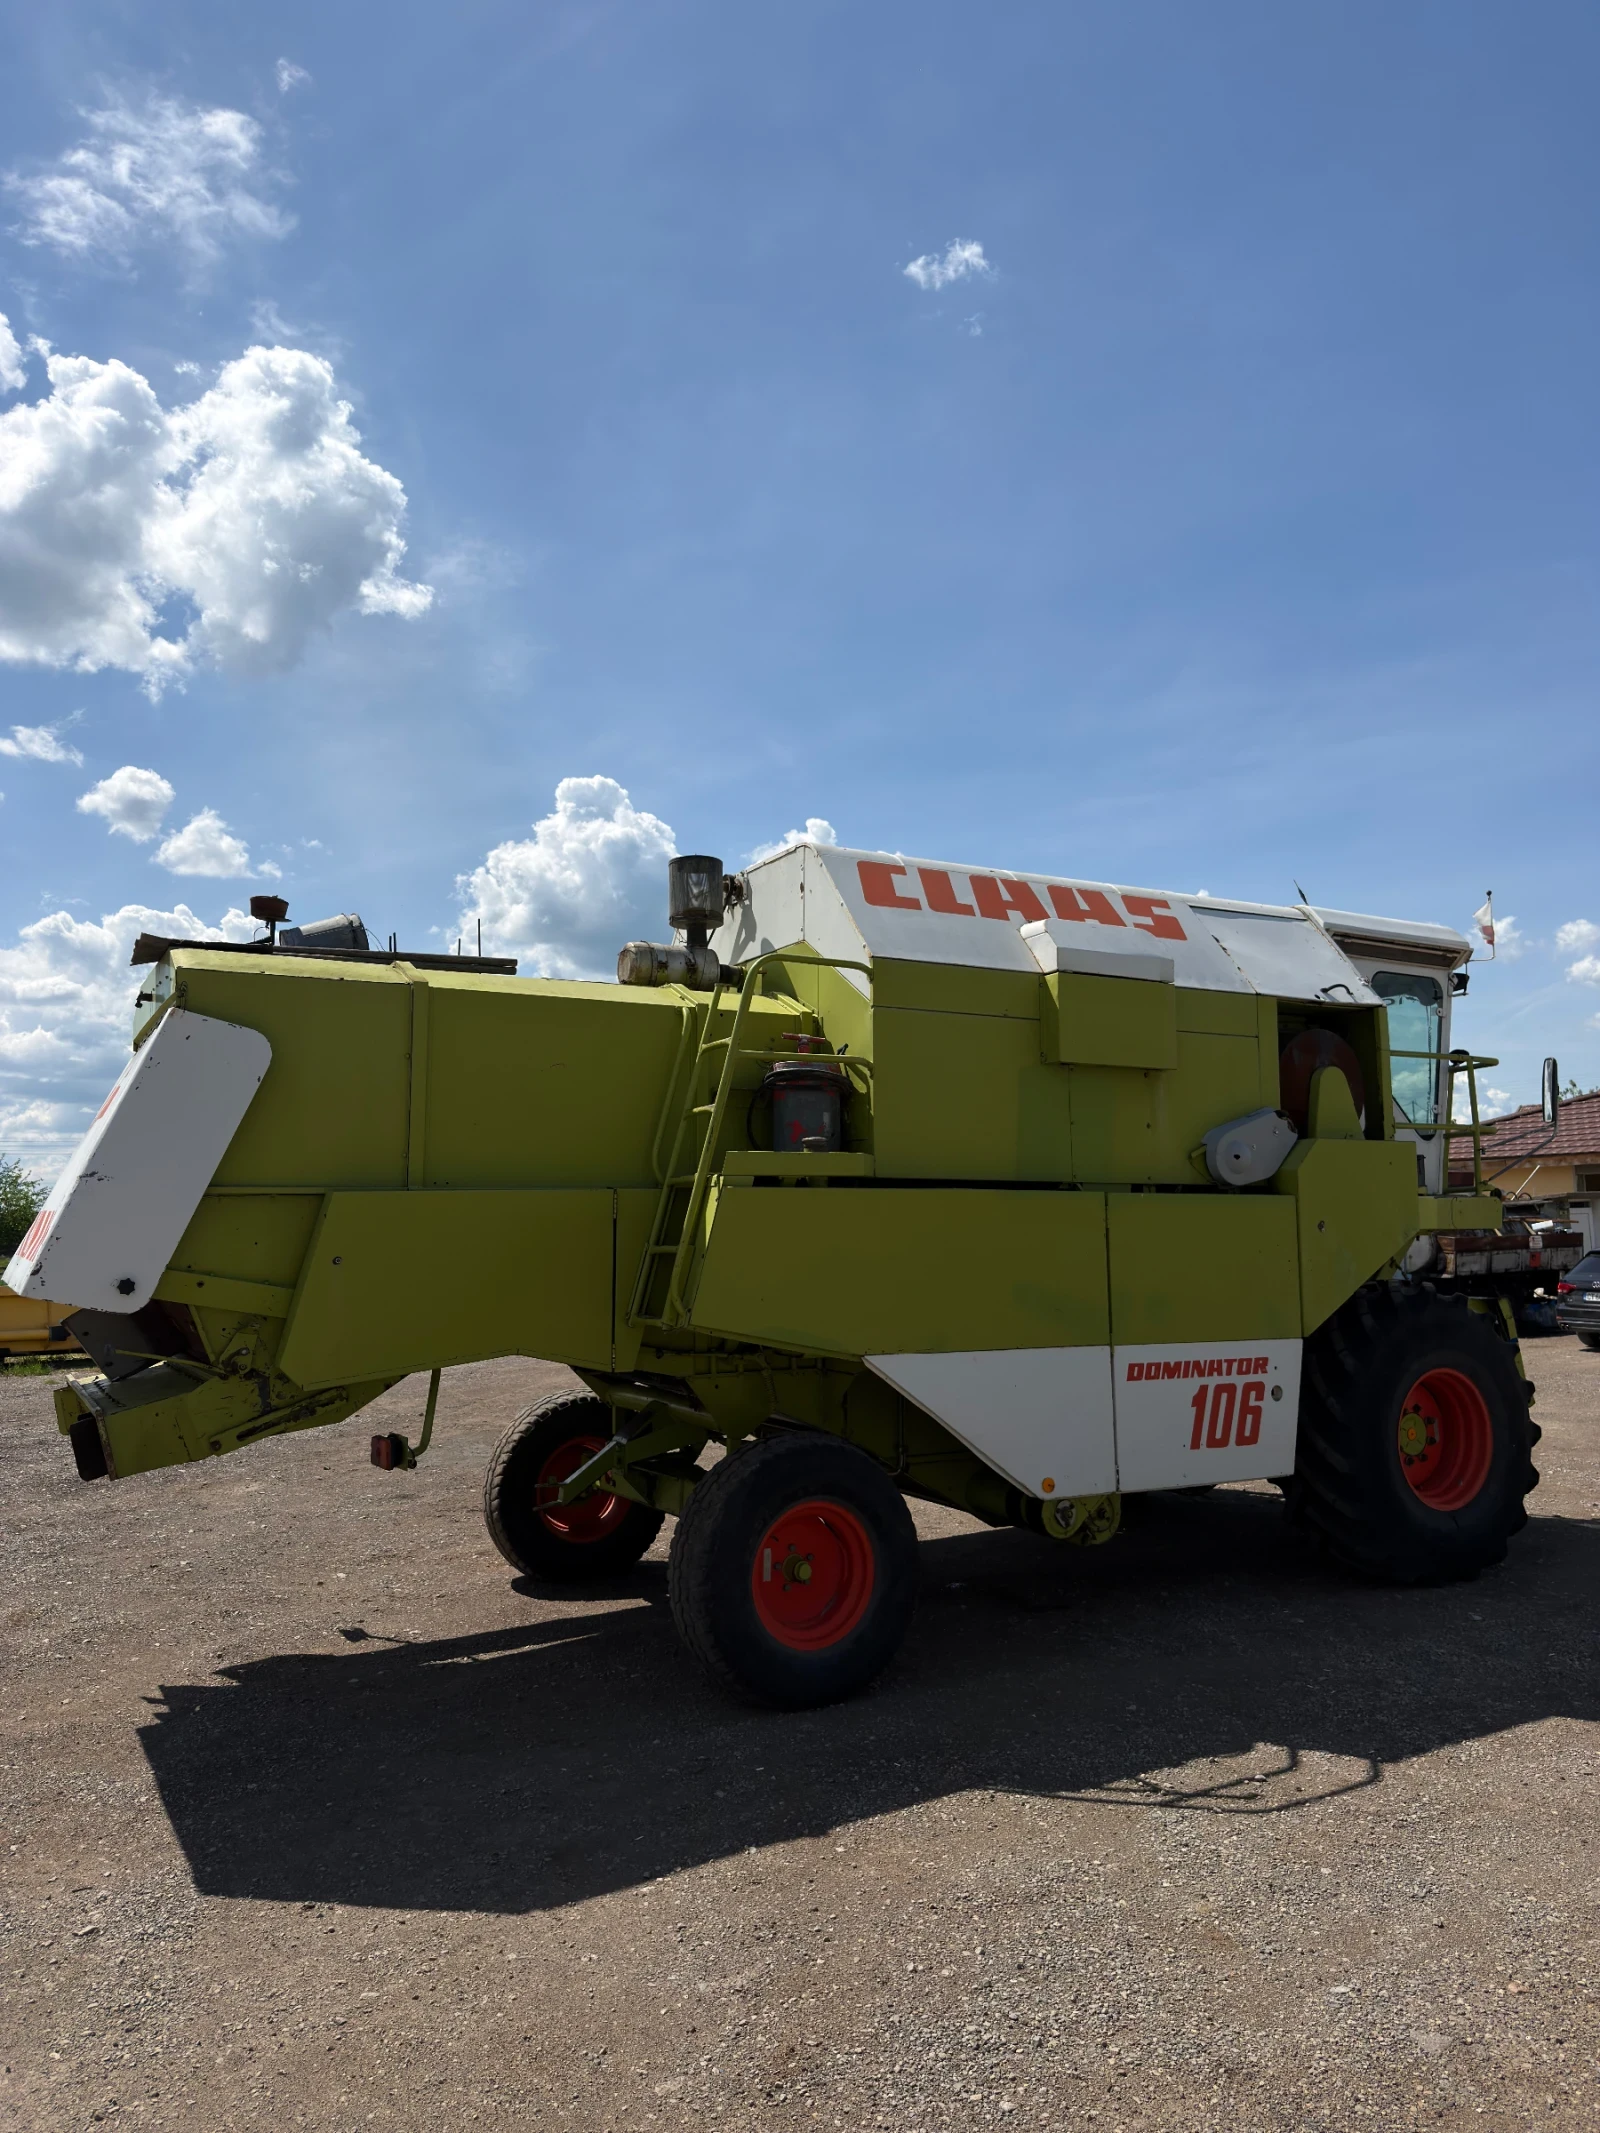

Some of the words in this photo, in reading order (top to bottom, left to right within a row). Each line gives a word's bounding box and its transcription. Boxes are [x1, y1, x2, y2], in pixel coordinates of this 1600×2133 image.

[857, 860, 1187, 941] CLAAS
[1126, 1357, 1269, 1381] DOMINATOR
[1190, 1381, 1265, 1450] 106
